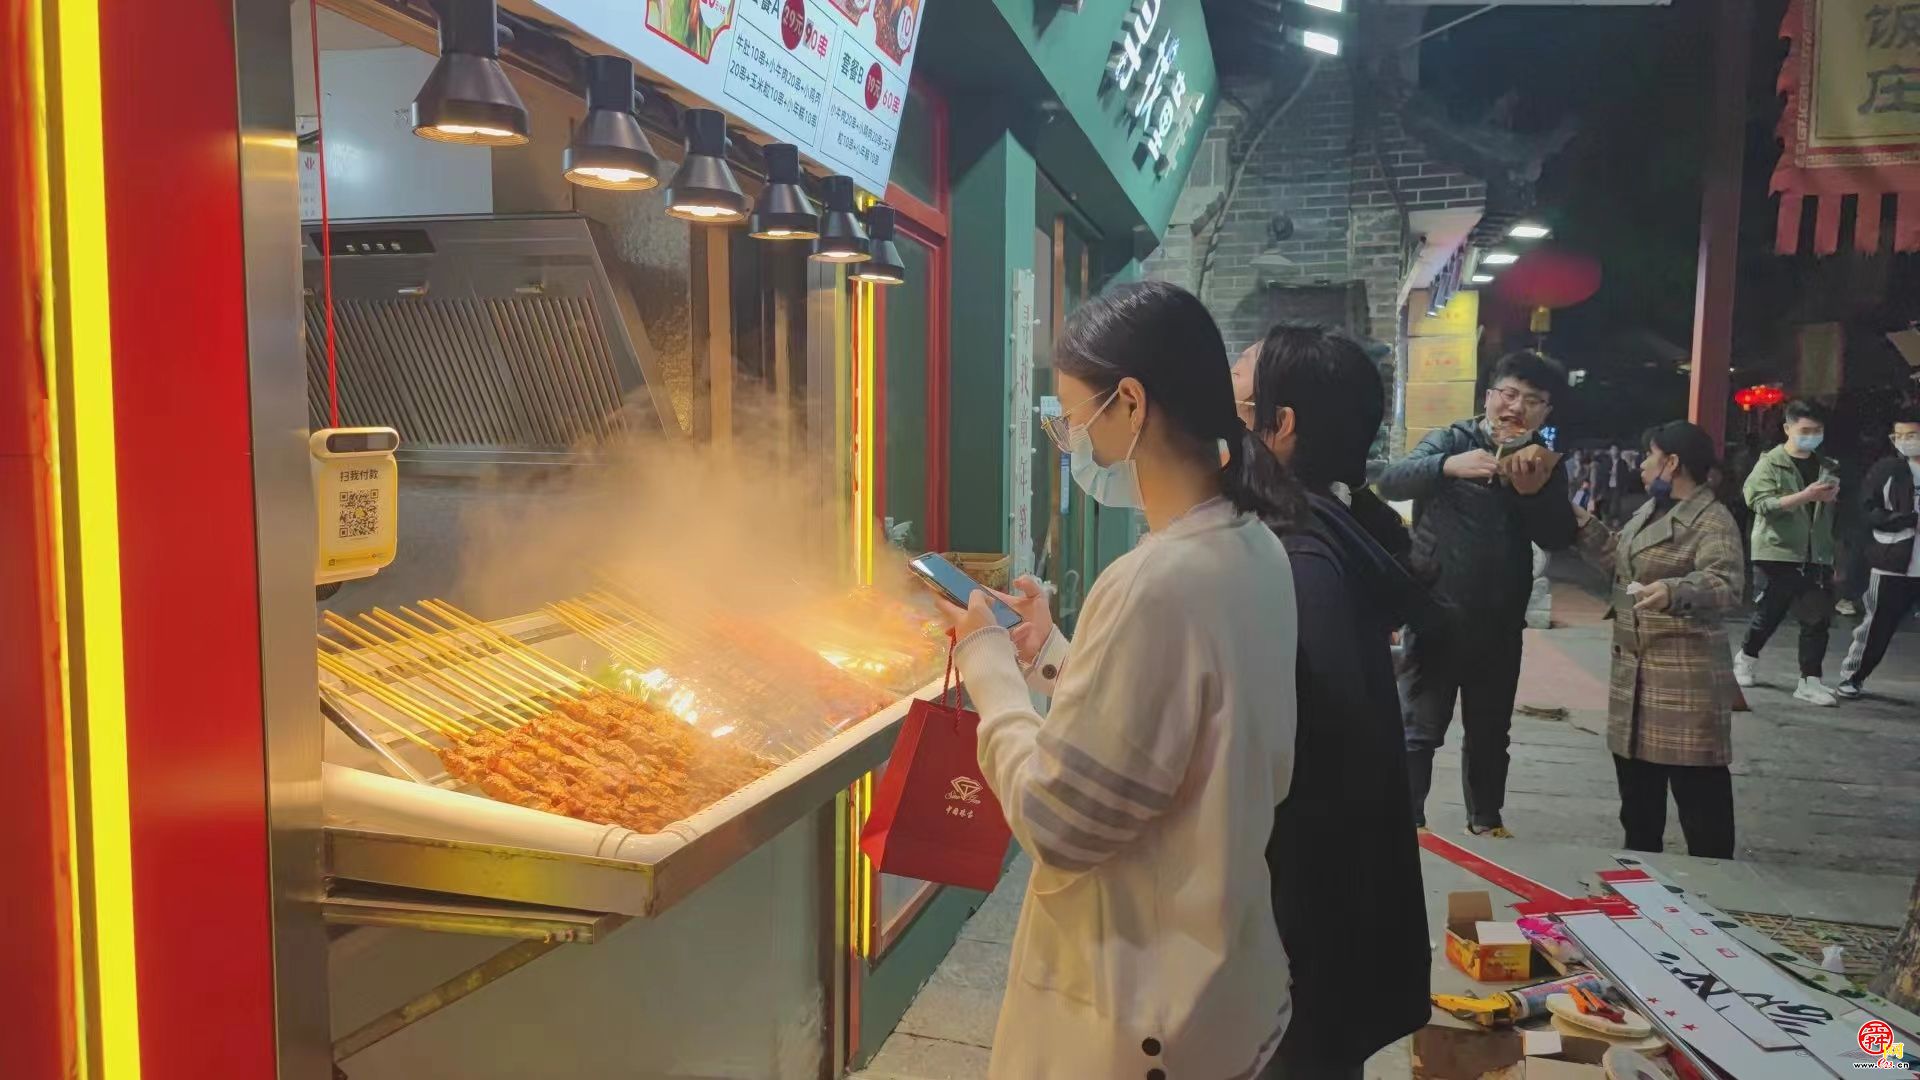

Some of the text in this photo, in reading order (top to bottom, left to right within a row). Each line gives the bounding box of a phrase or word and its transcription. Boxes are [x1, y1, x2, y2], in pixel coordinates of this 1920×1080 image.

[751, 0, 780, 20] 餐A
[901, 10, 912, 37] 10
[841, 52, 864, 85] 套餐B
[882, 89, 901, 115] 60串
[340, 468, 379, 483] 扫我付款
